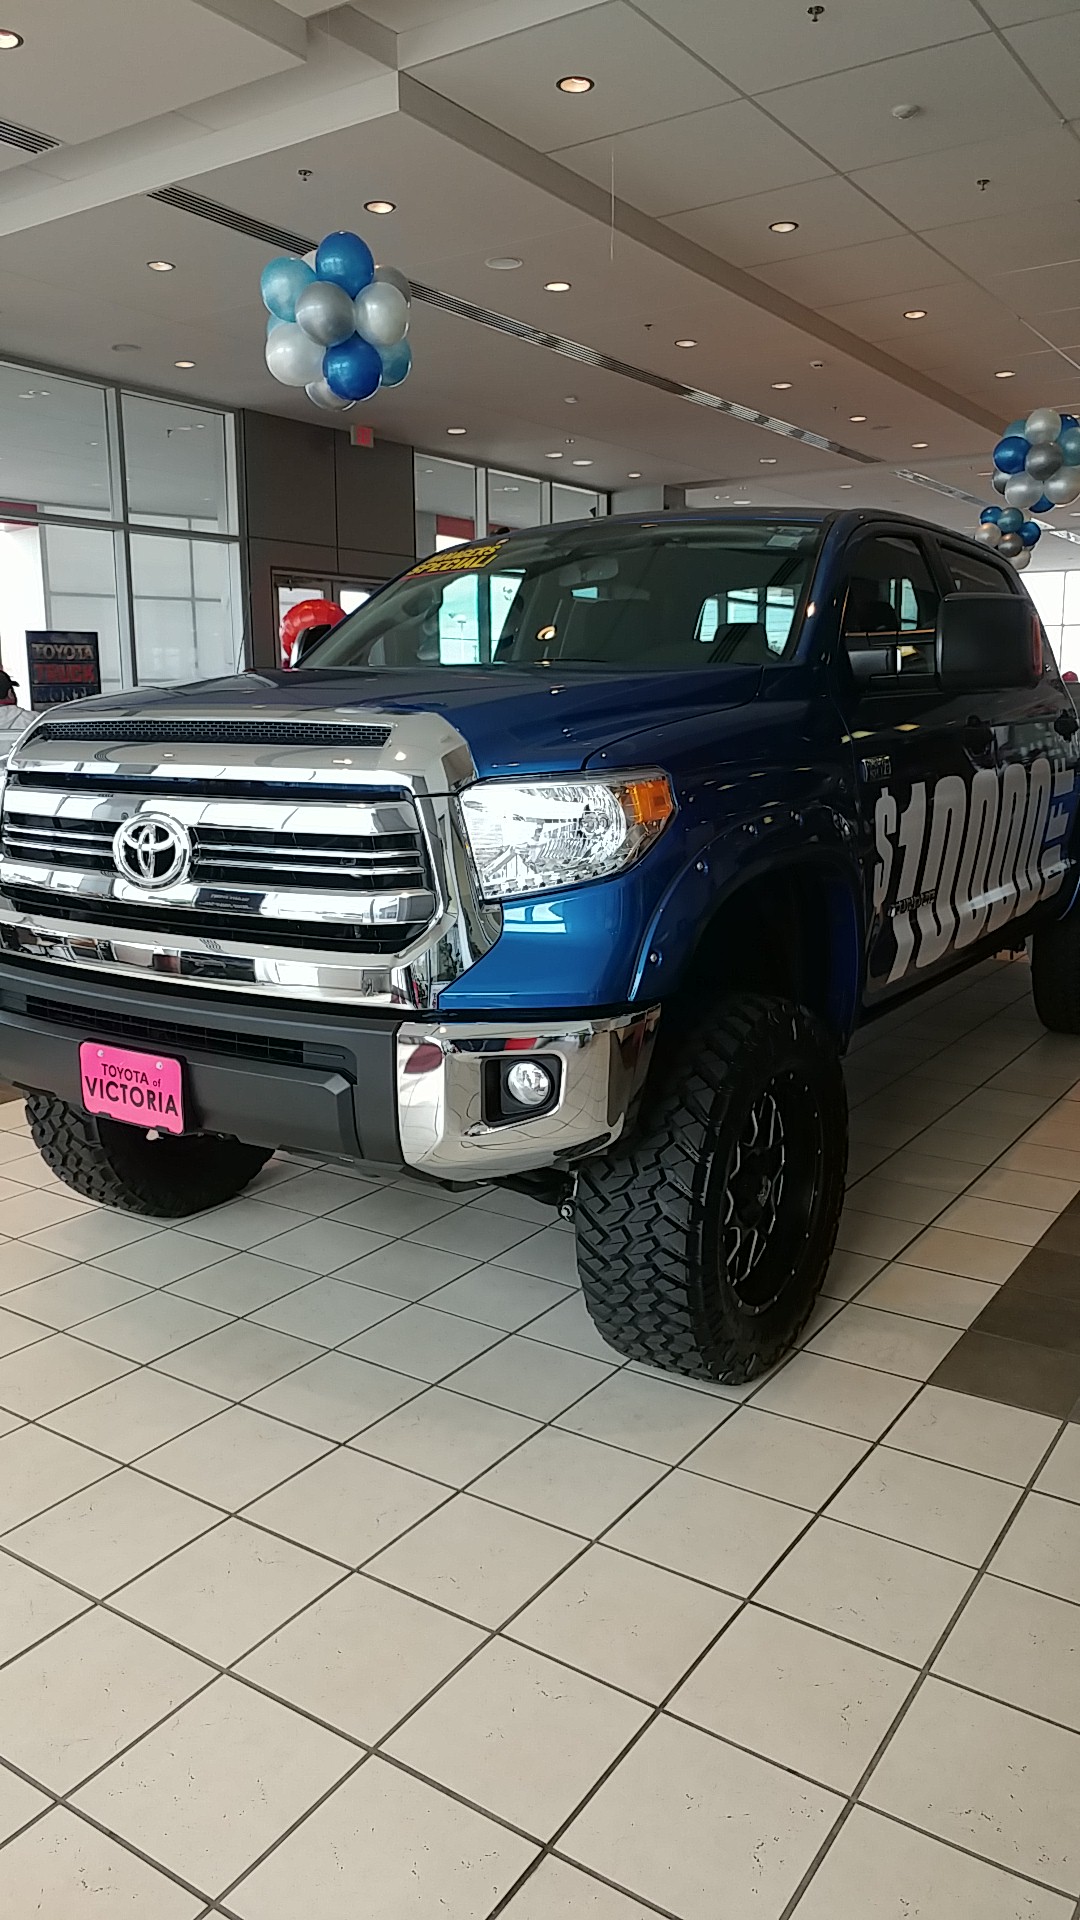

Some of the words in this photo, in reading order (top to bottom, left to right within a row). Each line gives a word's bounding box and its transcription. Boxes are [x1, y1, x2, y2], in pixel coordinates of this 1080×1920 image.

[31, 643, 94, 660] TOYOTA
[33, 663, 96, 683] TRUCK
[101, 1063, 149, 1086] TOYOTA
[152, 1078, 161, 1088] of
[85, 1076, 178, 1117] VICTORIA
